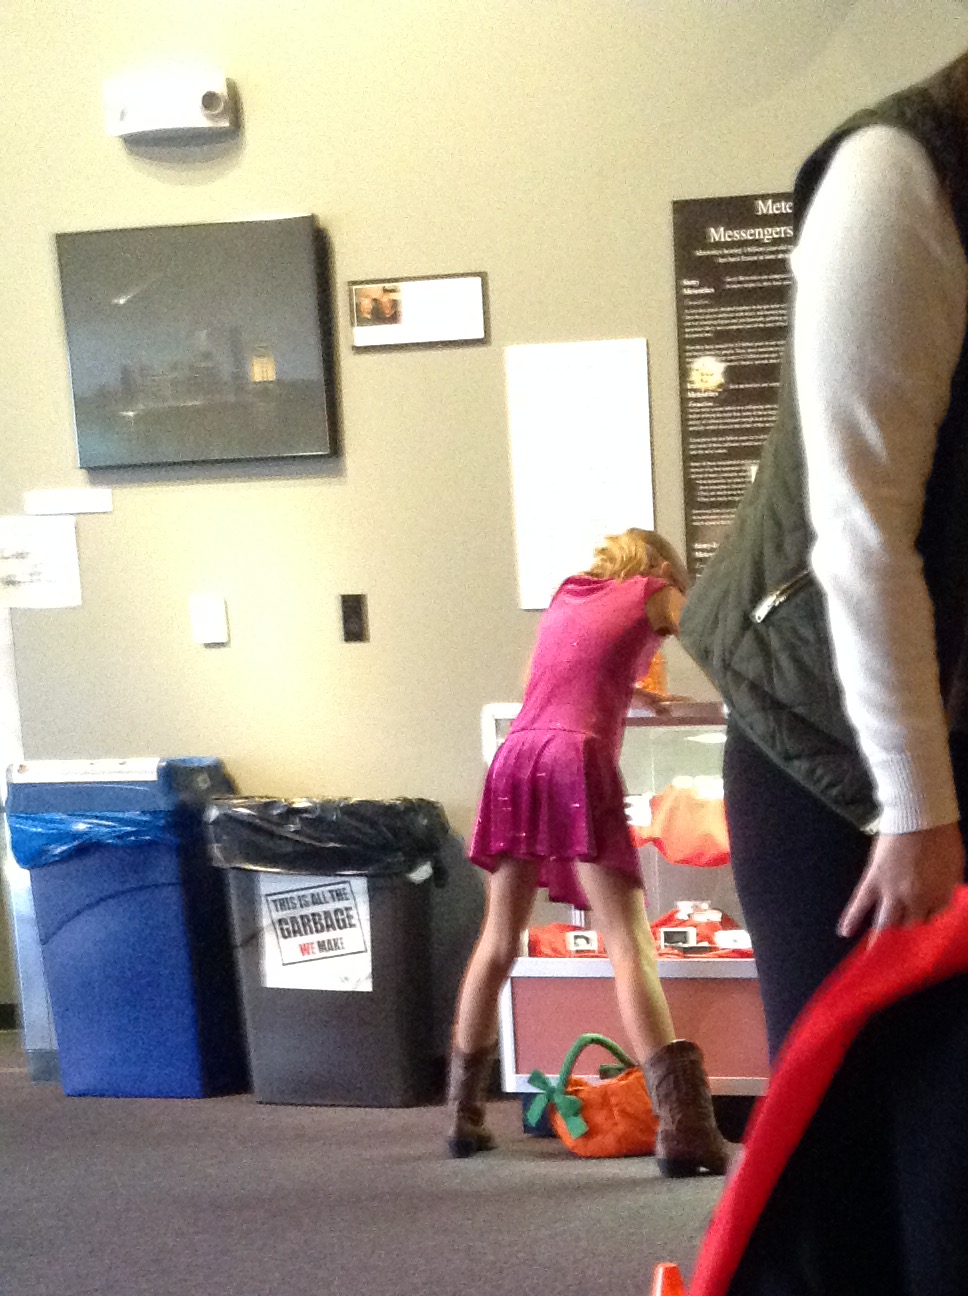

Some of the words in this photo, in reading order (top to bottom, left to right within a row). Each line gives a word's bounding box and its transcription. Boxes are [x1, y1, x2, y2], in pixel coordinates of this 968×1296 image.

[708, 225, 793, 243] Messengers
[271, 897, 297, 912] THIS
[298, 894, 309, 908] IS
[310, 891, 330, 906] ALL
[329, 888, 350, 902] THE
[278, 906, 357, 939] GARBAGE
[299, 942, 316, 956] WE
[317, 938, 345, 953] MAKE
